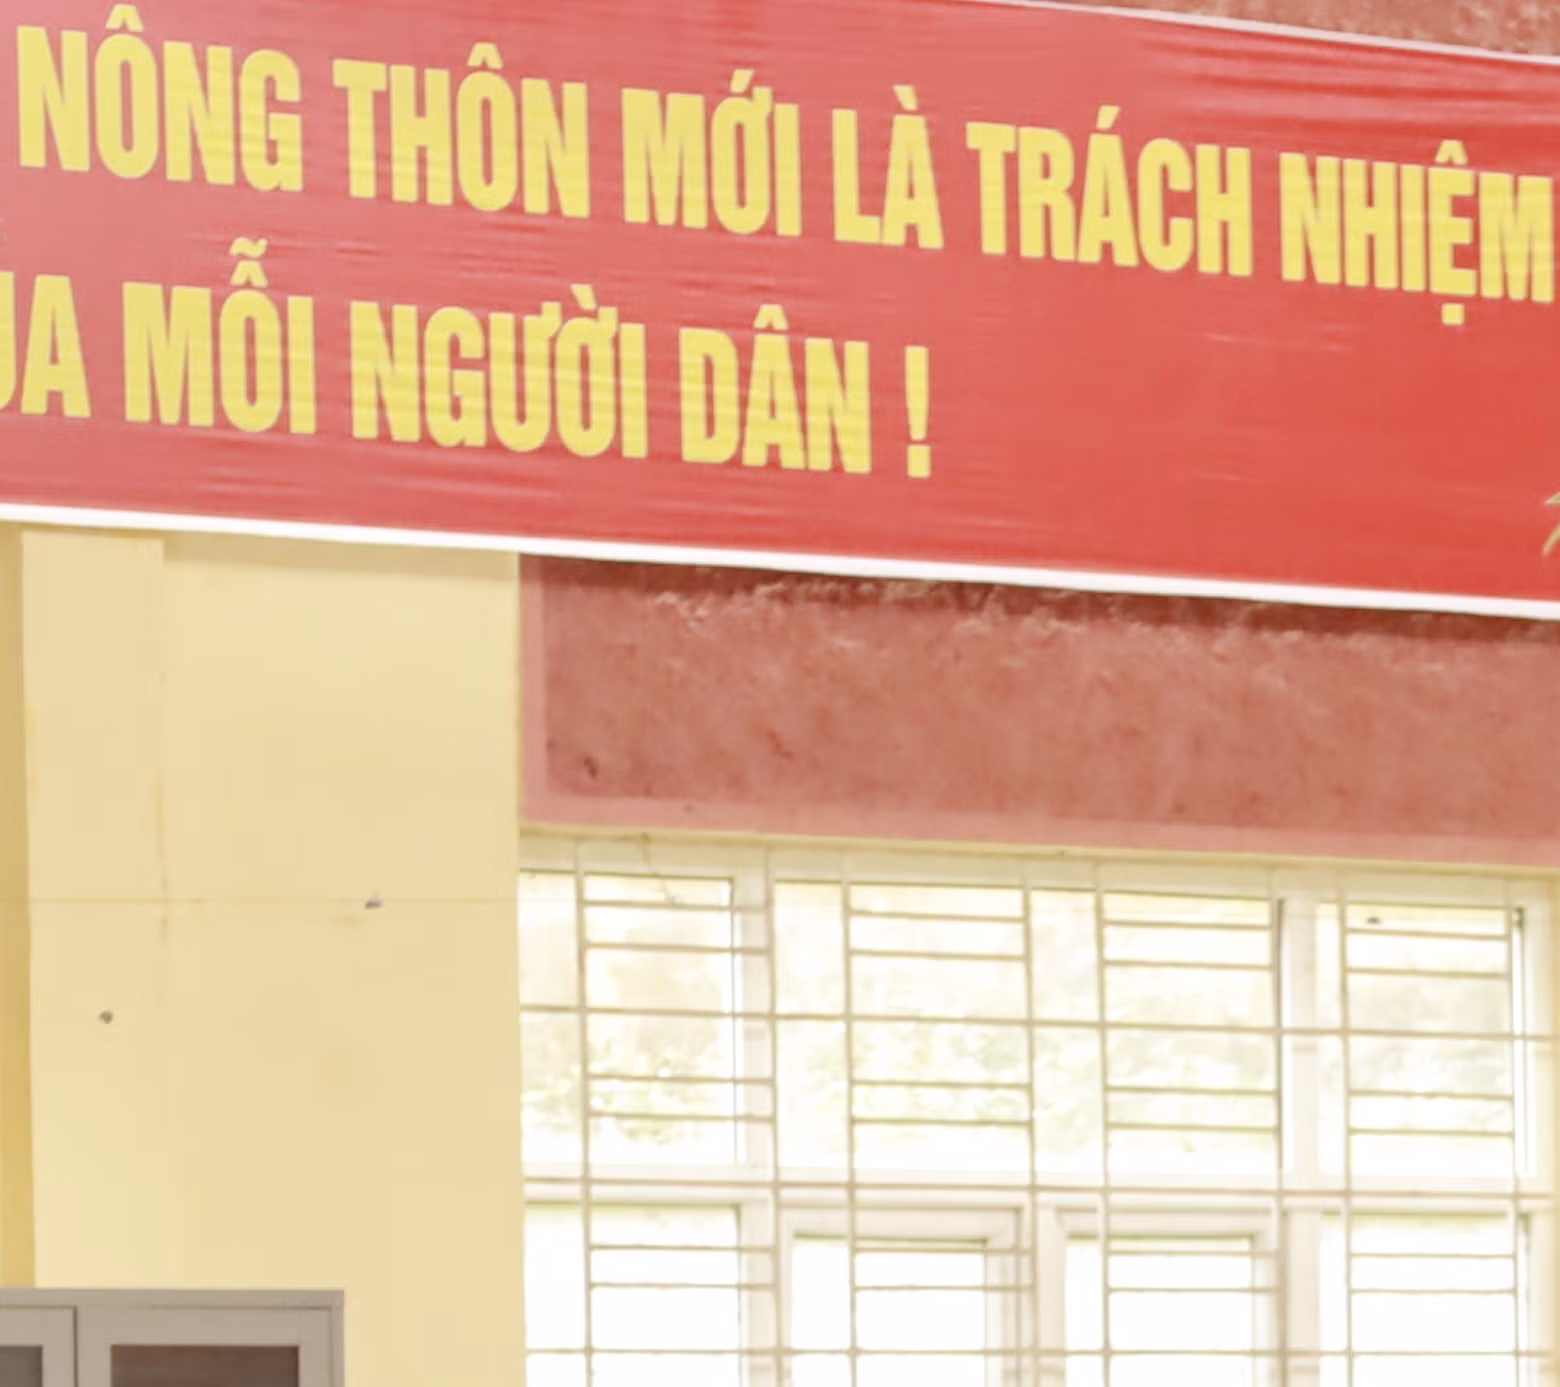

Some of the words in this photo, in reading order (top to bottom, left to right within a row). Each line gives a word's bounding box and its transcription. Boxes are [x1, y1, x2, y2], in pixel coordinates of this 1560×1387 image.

[17, 3, 303, 193] NÔNG
[333, 42, 590, 218] THÔN
[621, 68, 801, 238] MỚI
[831, 84, 944, 249] LÀ
[964, 104, 1251, 277] TRÁCH
[1279, 139, 1557, 326] NHIỆM
[121, 236, 316, 434] MỖI
[350, 283, 647, 459] NGƯỜI
[678, 303, 872, 475] DÂN
[903, 345, 932, 478] !
